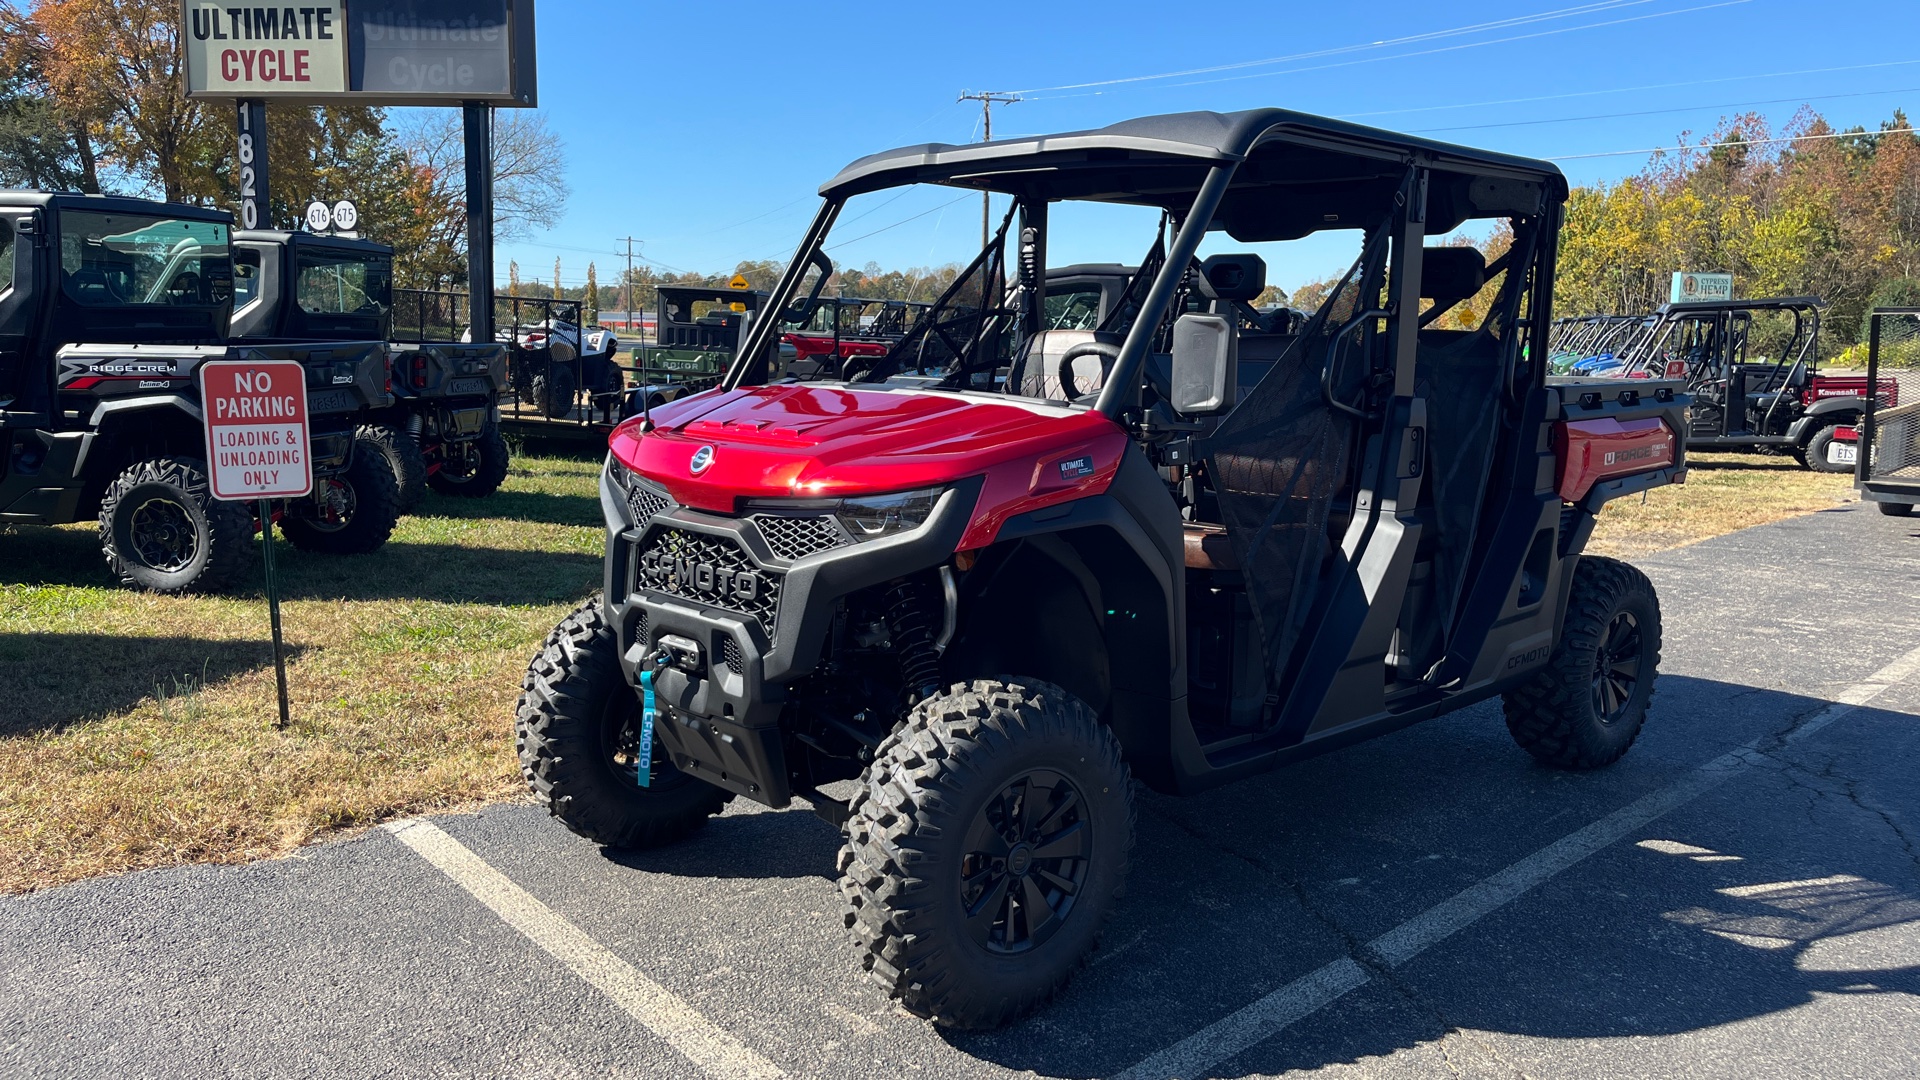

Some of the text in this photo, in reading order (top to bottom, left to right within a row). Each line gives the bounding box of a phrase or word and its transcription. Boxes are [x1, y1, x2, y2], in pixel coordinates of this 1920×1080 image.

[192, 7, 334, 41] ULTIMATE
[364, 10, 500, 42] Ultimate
[220, 49, 311, 82] CYCLE
[388, 56, 475, 89] Cycle
[238, 101, 258, 230] 1820
[310, 209, 327, 223] 676
[336, 208, 354, 222] 675
[1700, 285, 1728, 295] HEMP
[234, 371, 272, 393] NO
[451, 379, 484, 392] Kawasaki
[215, 395, 296, 419] PARKING
[219, 430, 297, 447] LOADING &
[220, 449, 300, 467] UNLOADING
[1060, 458, 1084, 472] ULTIMATE
[243, 470, 279, 486] ONLY
[643, 549, 757, 600] CFMOTO
[1507, 645, 1550, 669] CFMOTO
[641, 711, 653, 769] CFMOTO
